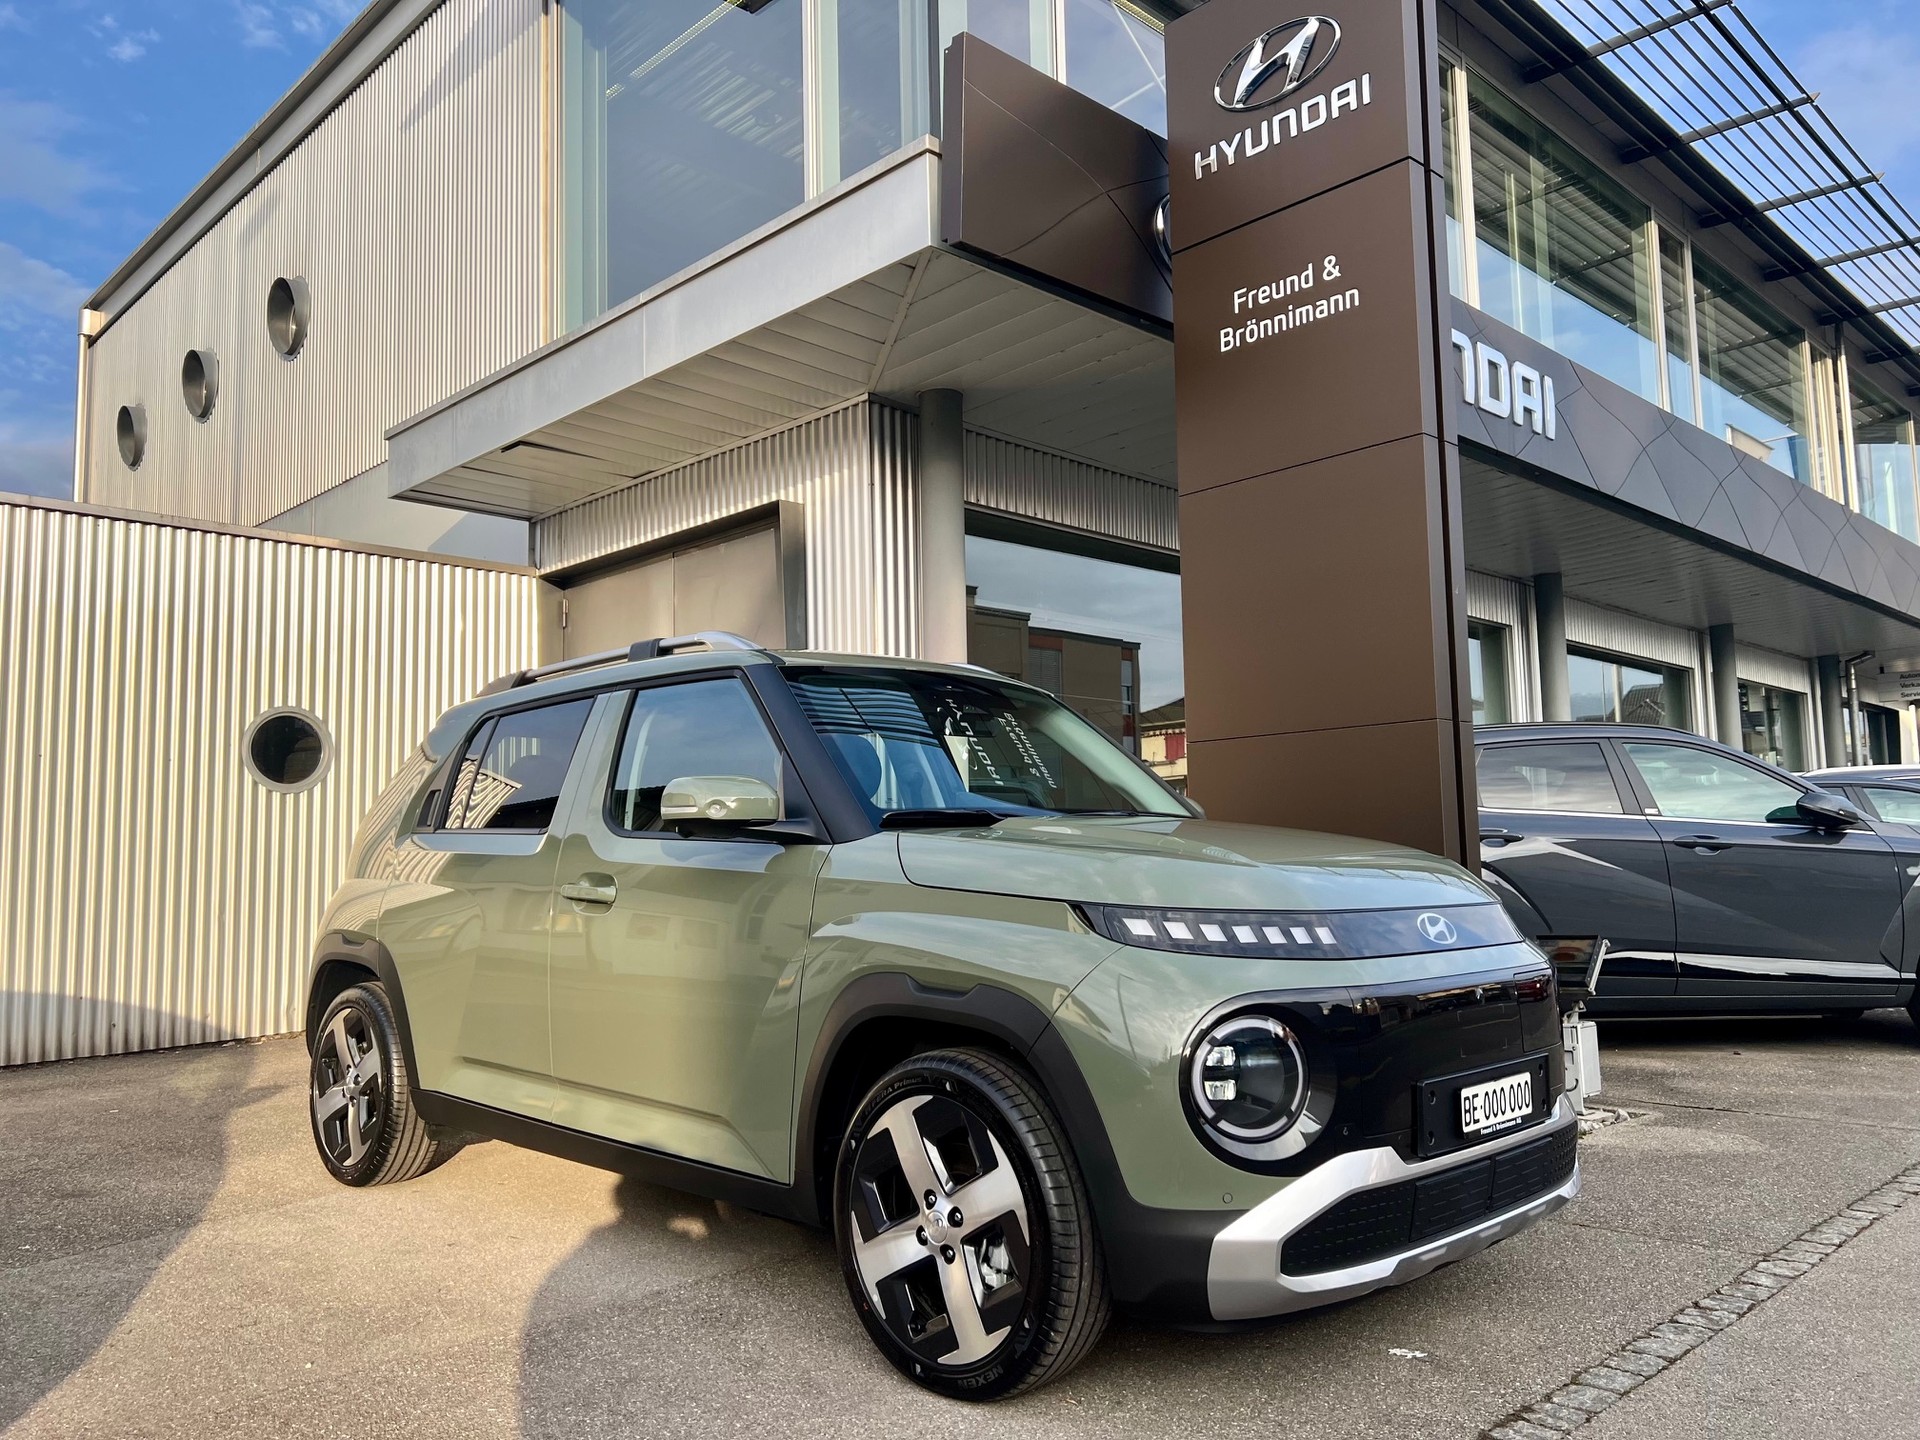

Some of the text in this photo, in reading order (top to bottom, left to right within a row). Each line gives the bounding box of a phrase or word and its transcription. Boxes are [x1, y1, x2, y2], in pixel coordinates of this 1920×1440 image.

[1194, 73, 1371, 180] HYUNDAI
[1233, 254, 1342, 314] Freund &
[1219, 288, 1360, 353] Brönnimann
